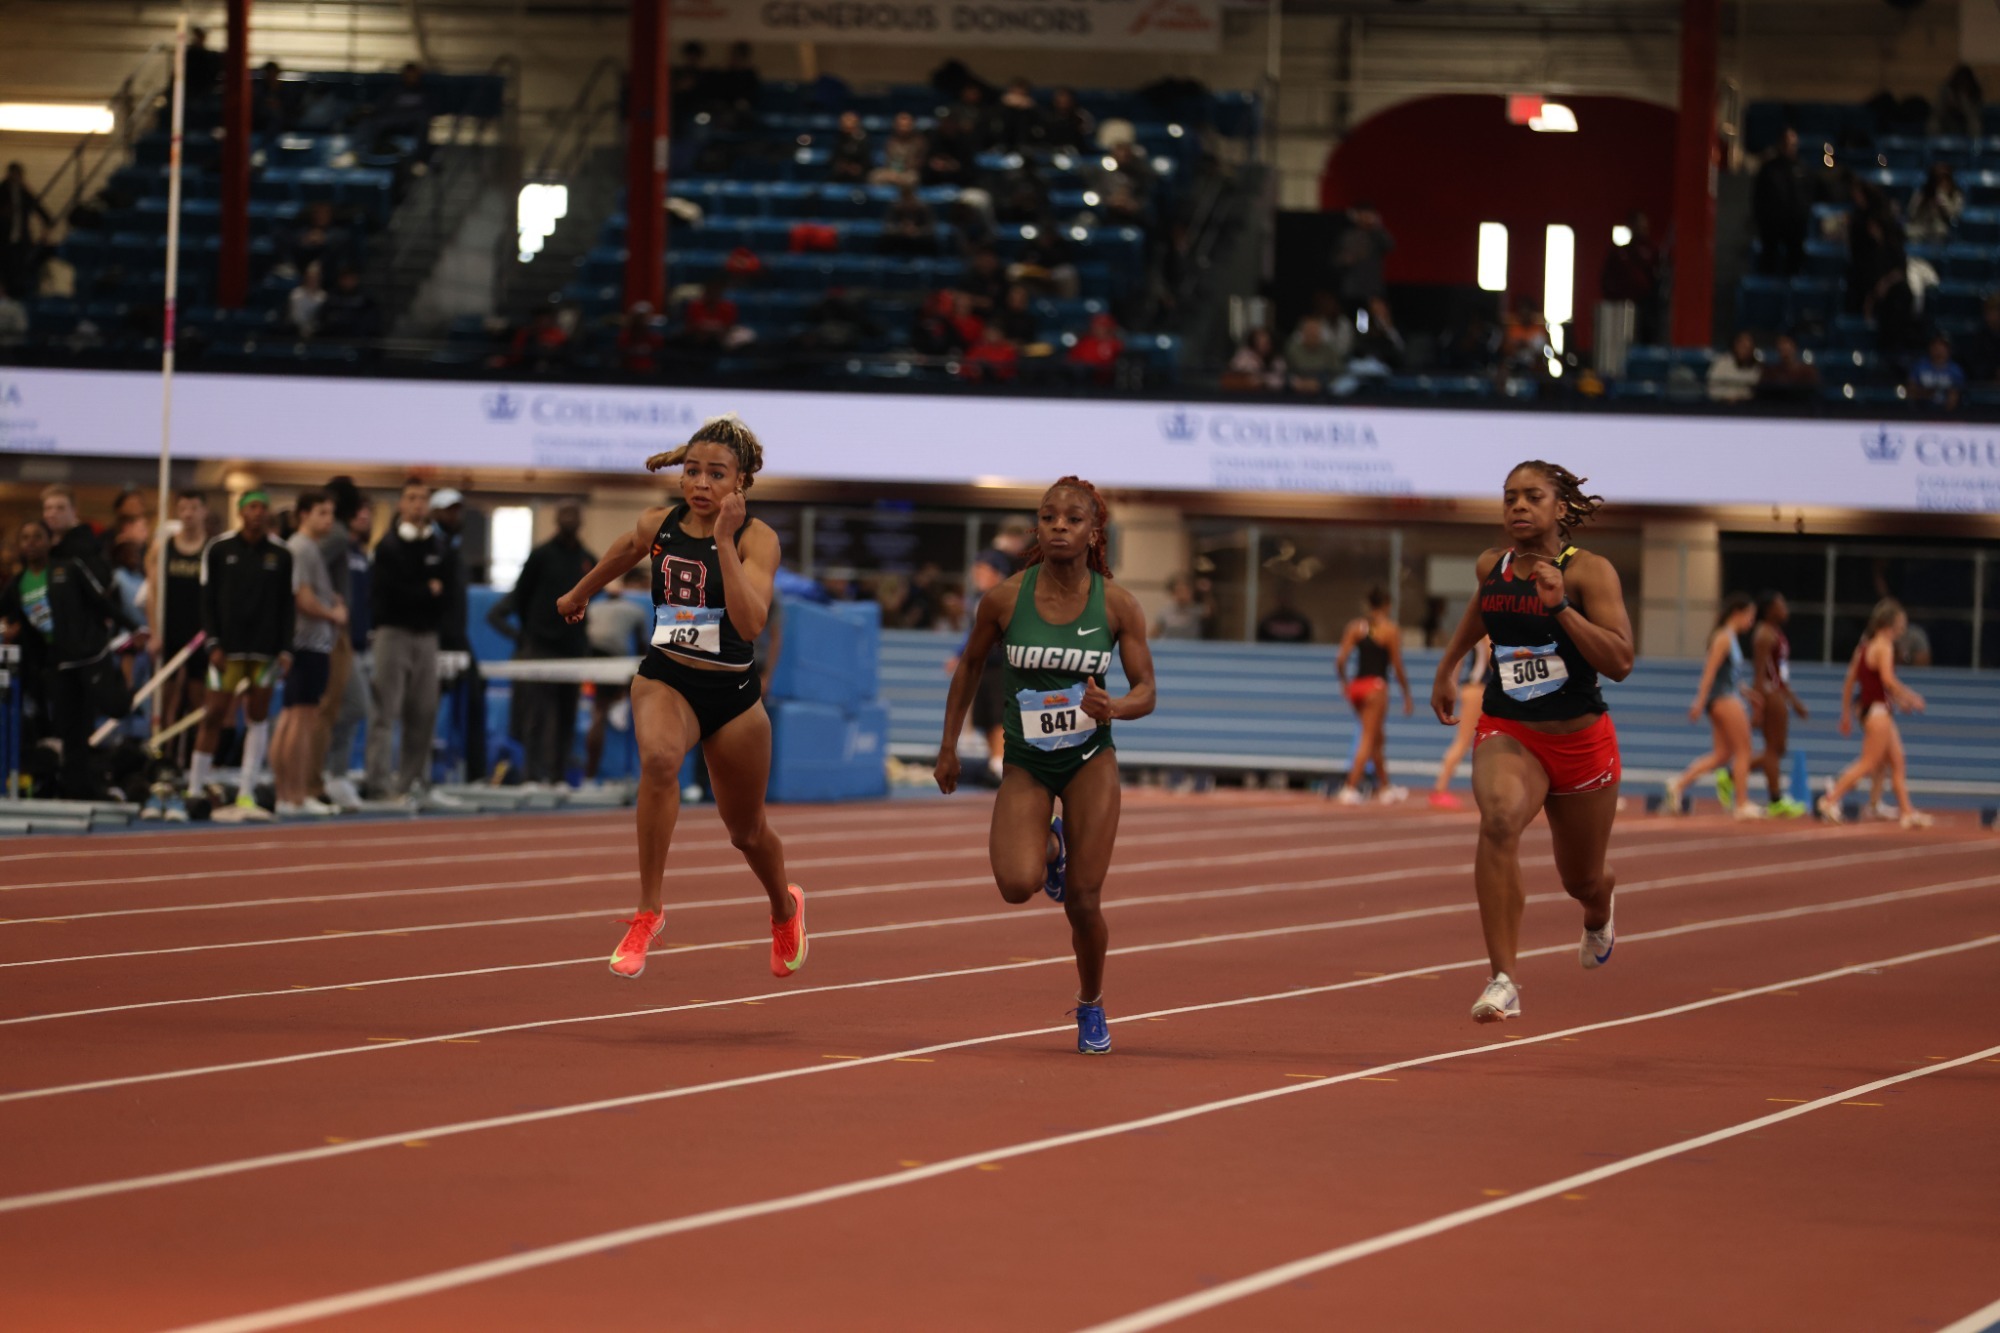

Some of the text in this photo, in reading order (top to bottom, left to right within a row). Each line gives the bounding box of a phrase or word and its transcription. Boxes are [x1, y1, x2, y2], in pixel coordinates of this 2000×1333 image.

[762, 2, 938, 31] GENEROUS
[951, 3, 1094, 36] DONORS
[1209, 415, 1379, 448] COLUMBIA
[661, 555, 707, 608] B
[669, 627, 700, 648] 162
[1006, 644, 1112, 675] WAGNER
[1513, 658, 1550, 685] 509
[1040, 709, 1077, 734] 847
